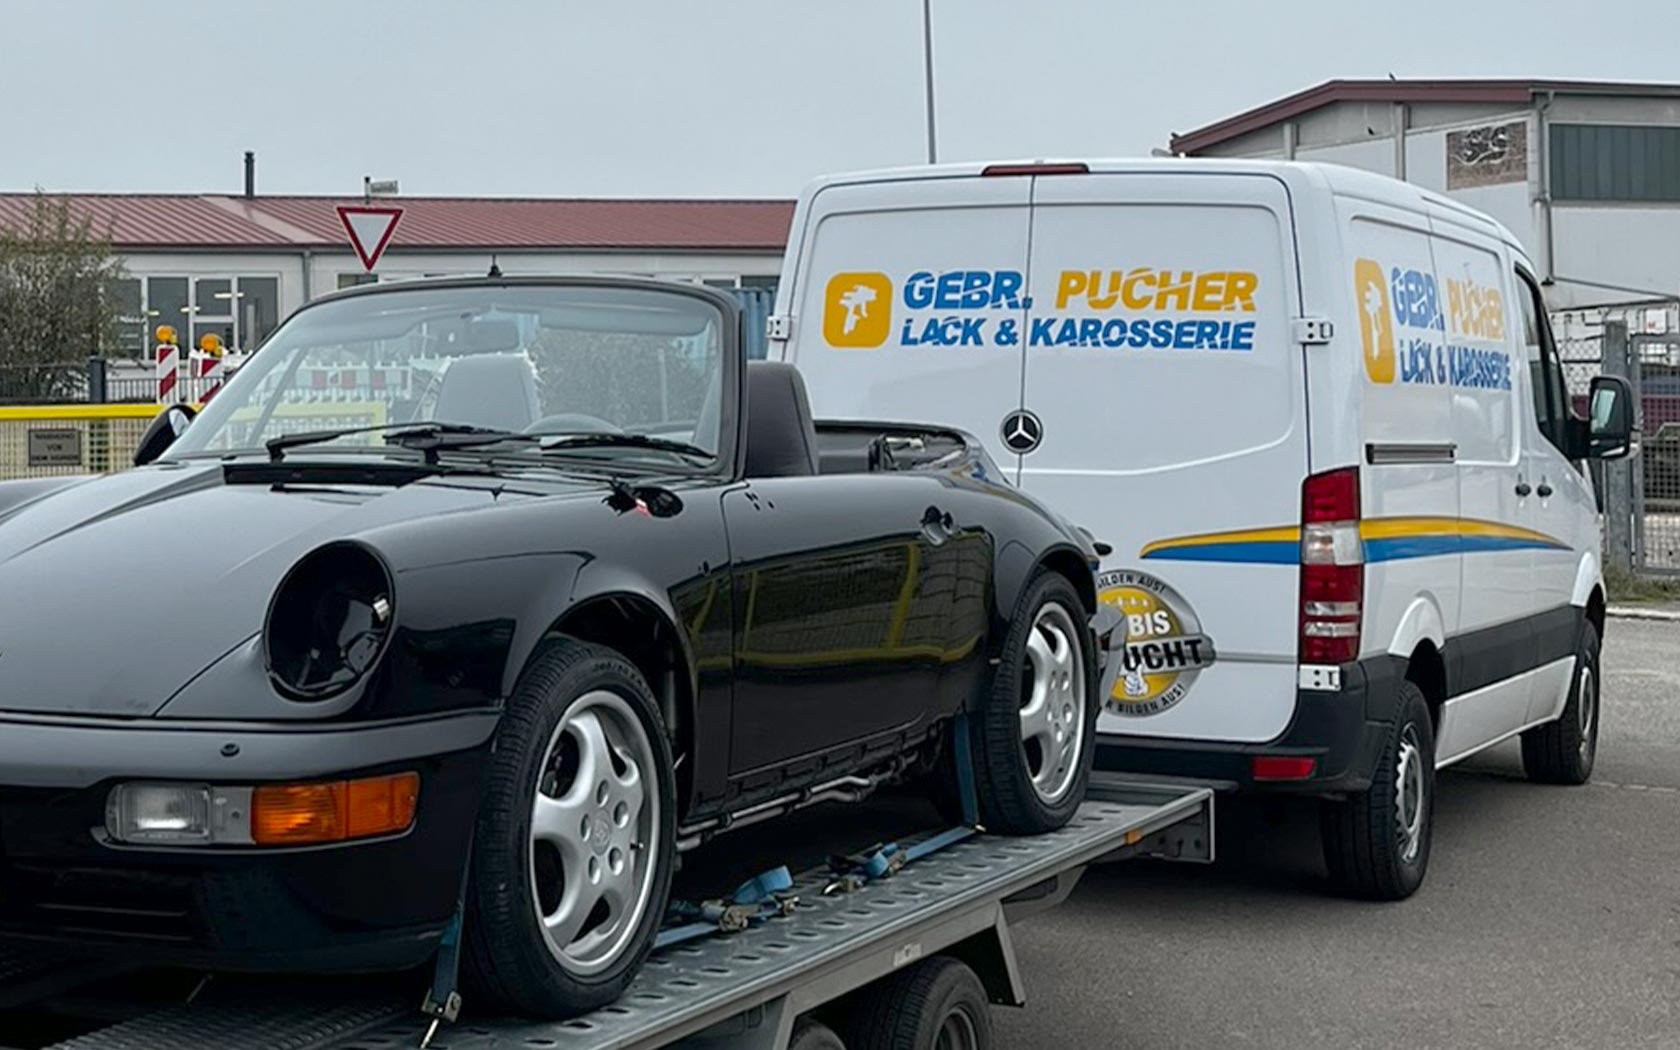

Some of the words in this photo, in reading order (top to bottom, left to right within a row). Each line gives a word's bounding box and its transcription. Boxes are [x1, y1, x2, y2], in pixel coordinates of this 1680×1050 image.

[904, 271, 1033, 309] GEBR.
[1056, 269, 1258, 311] PUCHER
[901, 316, 987, 346] LACK
[995, 318, 1019, 346] &
[1029, 317, 1256, 350] KAROSSERIE
[1127, 609, 1171, 637] BIS
[1123, 638, 1202, 672] UCHT
